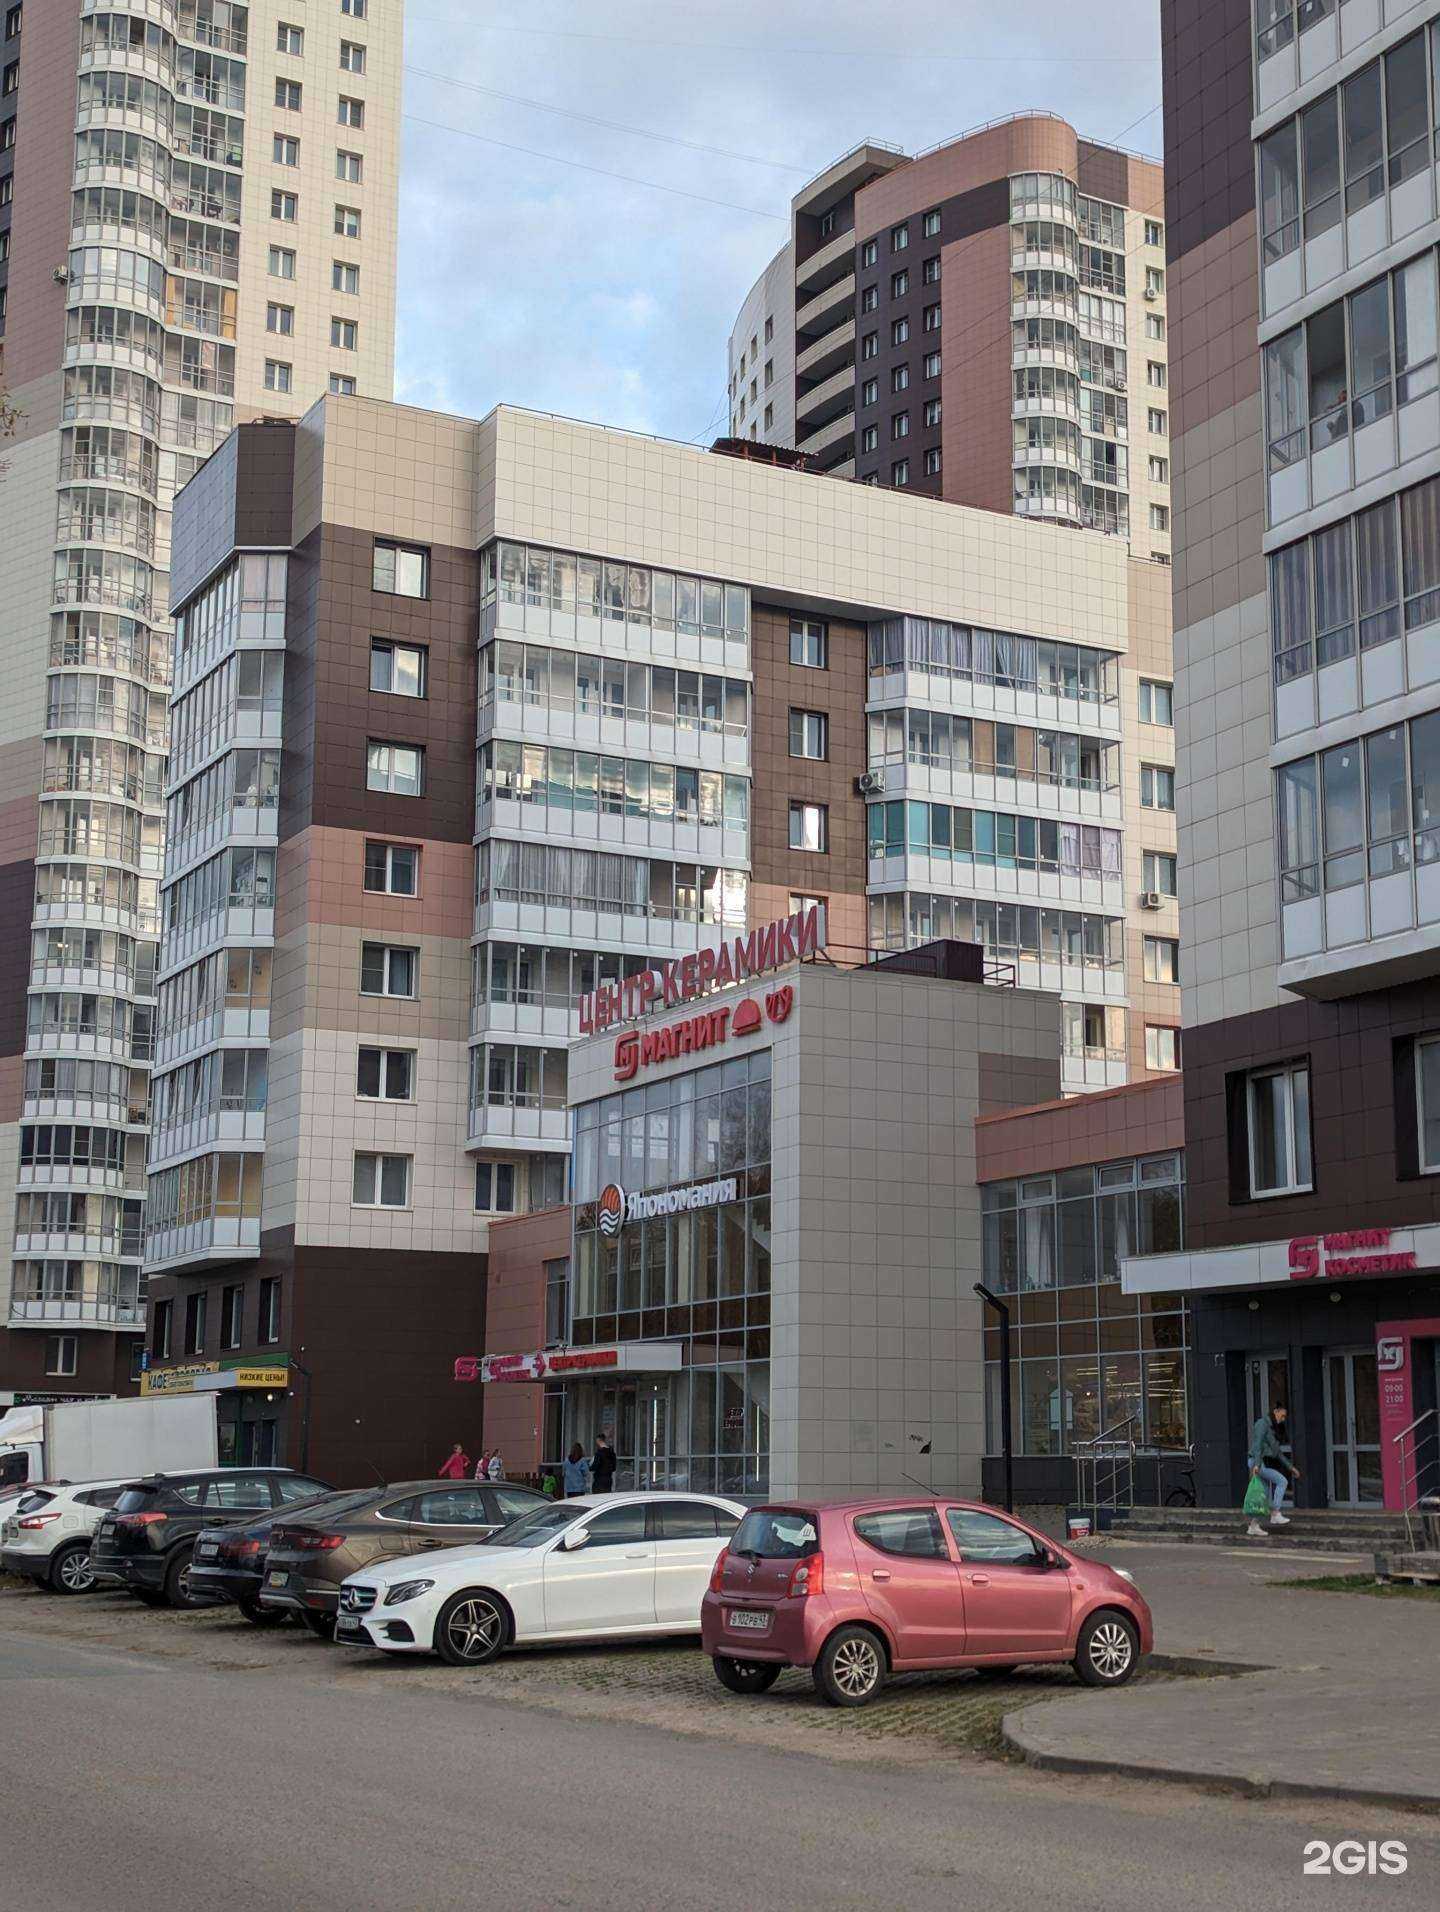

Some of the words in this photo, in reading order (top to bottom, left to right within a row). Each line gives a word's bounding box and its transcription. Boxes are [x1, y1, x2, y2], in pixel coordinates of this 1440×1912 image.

[579, 970, 660, 1034] ЦЕНТР
[663, 905, 822, 1007] КЕРАМИКИ
[640, 1007, 729, 1066] МАГНИТ
[626, 1178, 737, 1220] Япономания
[239, 1372, 264, 1381] НИЗКИЕ
